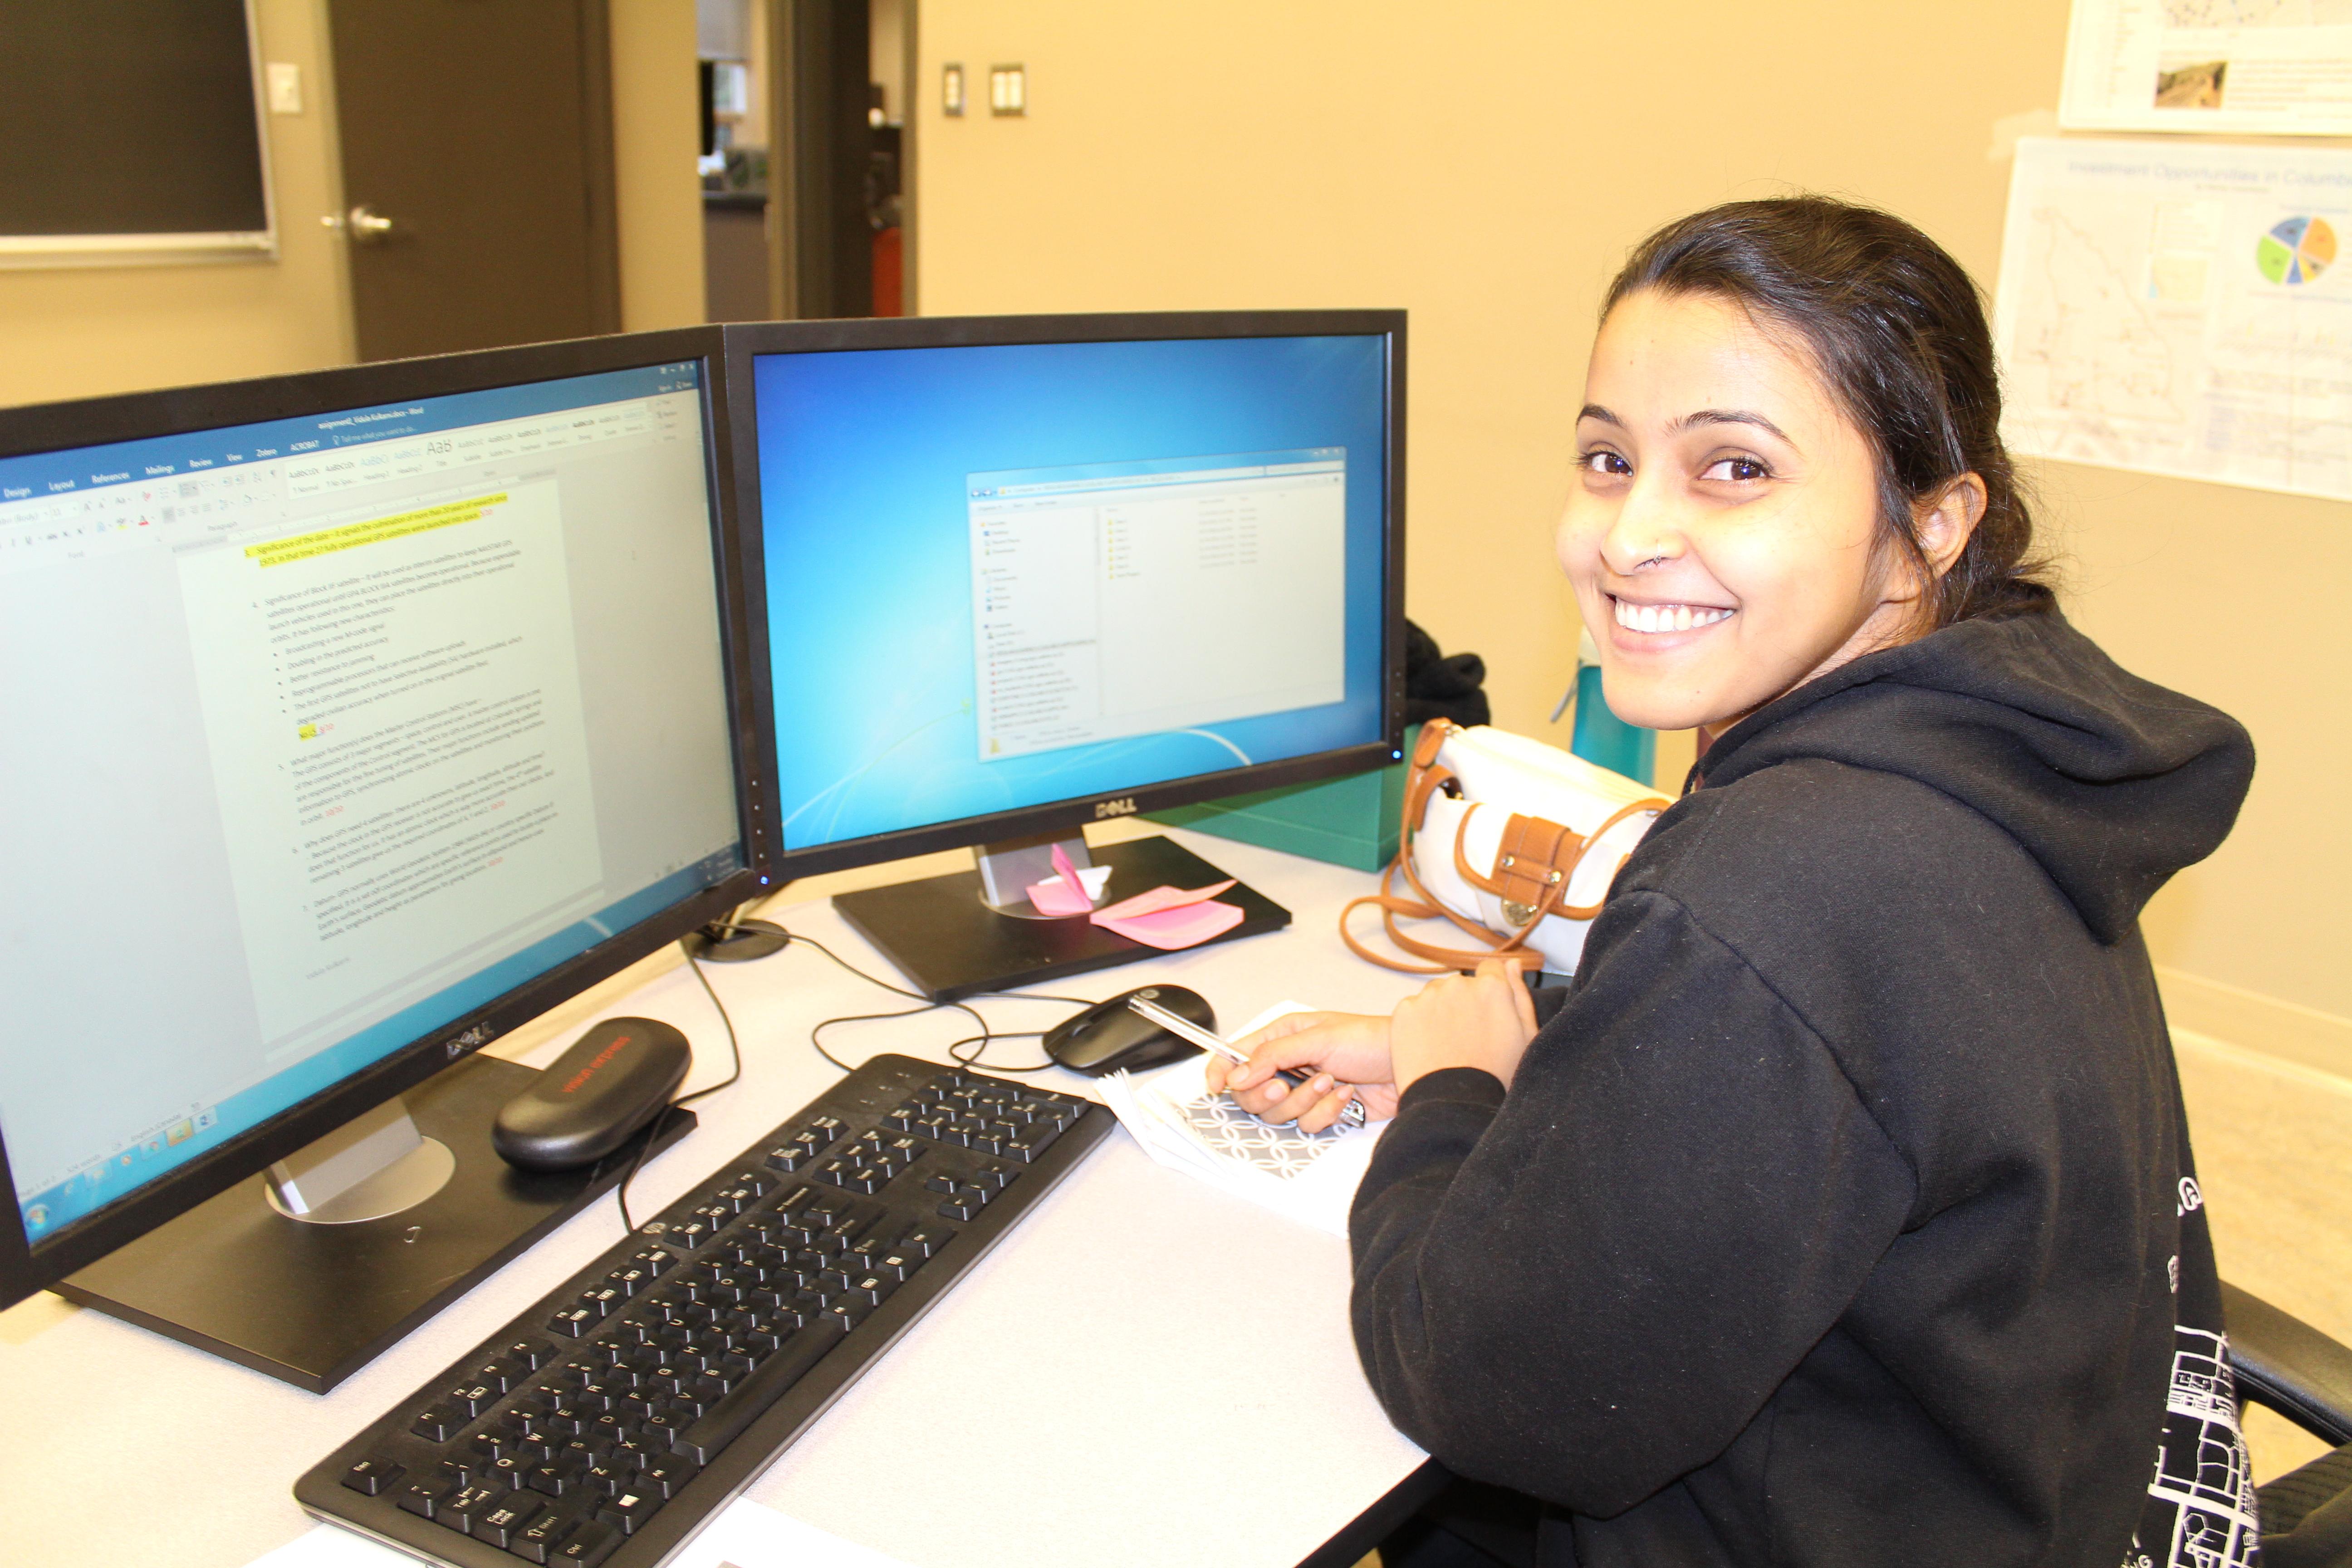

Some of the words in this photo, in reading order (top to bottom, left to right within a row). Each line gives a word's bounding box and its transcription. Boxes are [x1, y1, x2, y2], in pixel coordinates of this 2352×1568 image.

[2283, 168, 2352, 187] Columbi
[256, 446, 278, 458] Zotero
[290, 440, 320, 452] ACROBAT
[189, 457, 213, 469] Review
[225, 453, 244, 463] View
[145, 462, 175, 476] Mailings
[91, 470, 131, 484] References
[49, 478, 75, 492] Layout
[4, 485, 32, 499] Design
[1095, 797, 1137, 818] DELL
[446, 1020, 495, 1059] DELL
[526, 1433, 544, 1441] W
[353, 1460, 372, 1472] Esc
[497, 1458, 514, 1467] Q
[591, 1467, 607, 1475] Z
[453, 1497, 472, 1509] Tab
[540, 1516, 558, 1529] Shift
[566, 1542, 584, 1555] Ctrl
